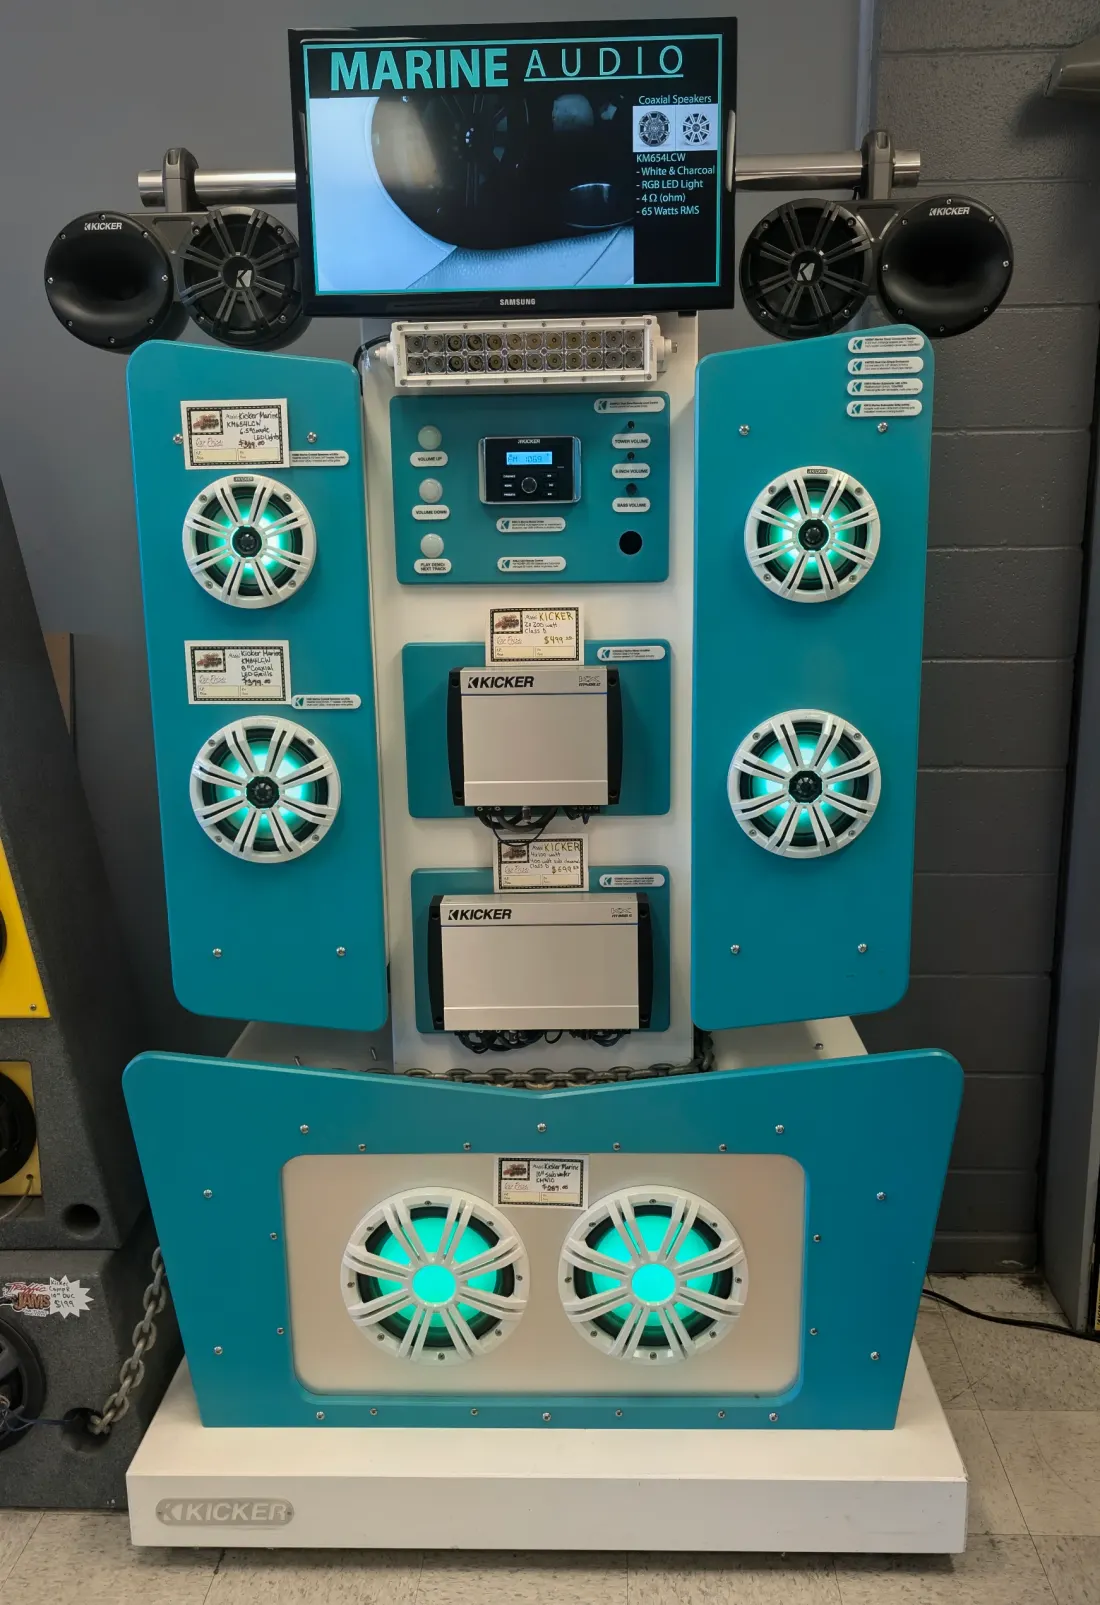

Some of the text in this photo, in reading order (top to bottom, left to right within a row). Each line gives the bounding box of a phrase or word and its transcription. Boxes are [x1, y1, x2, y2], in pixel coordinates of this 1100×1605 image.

[330, 45, 684, 91] MARINE AUDIO
[638, 94, 712, 105] Coaxial Speakers
[636, 152, 686, 163] KM654LCW
[641, 165, 716, 176] White & Charcoal
[641, 179, 704, 190] RGB LED Light
[641, 194, 648, 202] 4
[660, 193, 686, 203] (ohm)
[641, 205, 700, 216] 65 Watts RMS
[936, 207, 970, 216] KICKER
[91, 222, 123, 231] KICKER
[500, 298, 536, 306] SAMSUNG
[539, 611, 574, 621] KICKER
[479, 676, 535, 689] KICKER
[544, 842, 581, 852] KICKER
[459, 908, 512, 921] KICKER
[185, 1502, 287, 1521] KICKER
